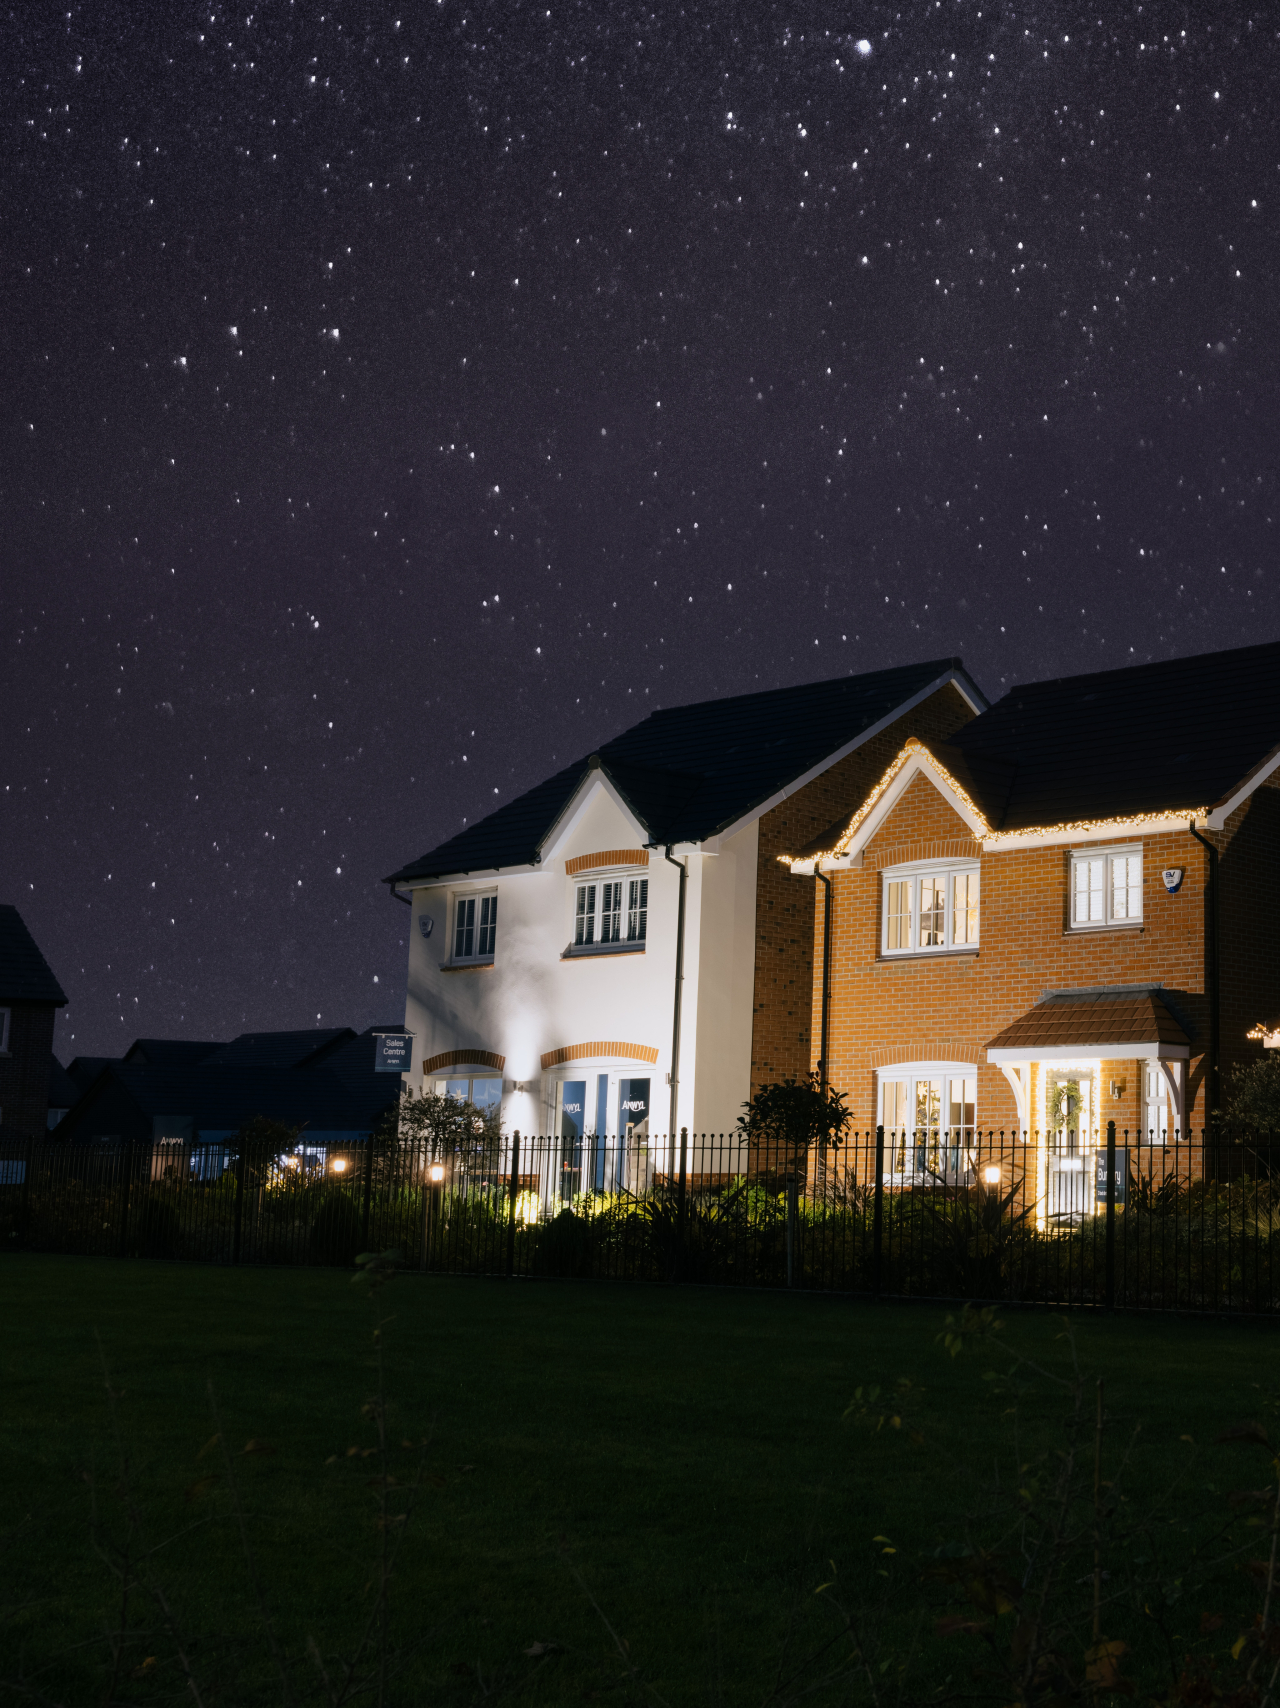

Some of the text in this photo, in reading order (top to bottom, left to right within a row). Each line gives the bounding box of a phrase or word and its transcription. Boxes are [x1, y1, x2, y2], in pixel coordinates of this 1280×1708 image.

[385, 1039, 404, 1047] Sales
[383, 1048, 406, 1056] Centre
[1097, 1157, 1105, 1166] The
